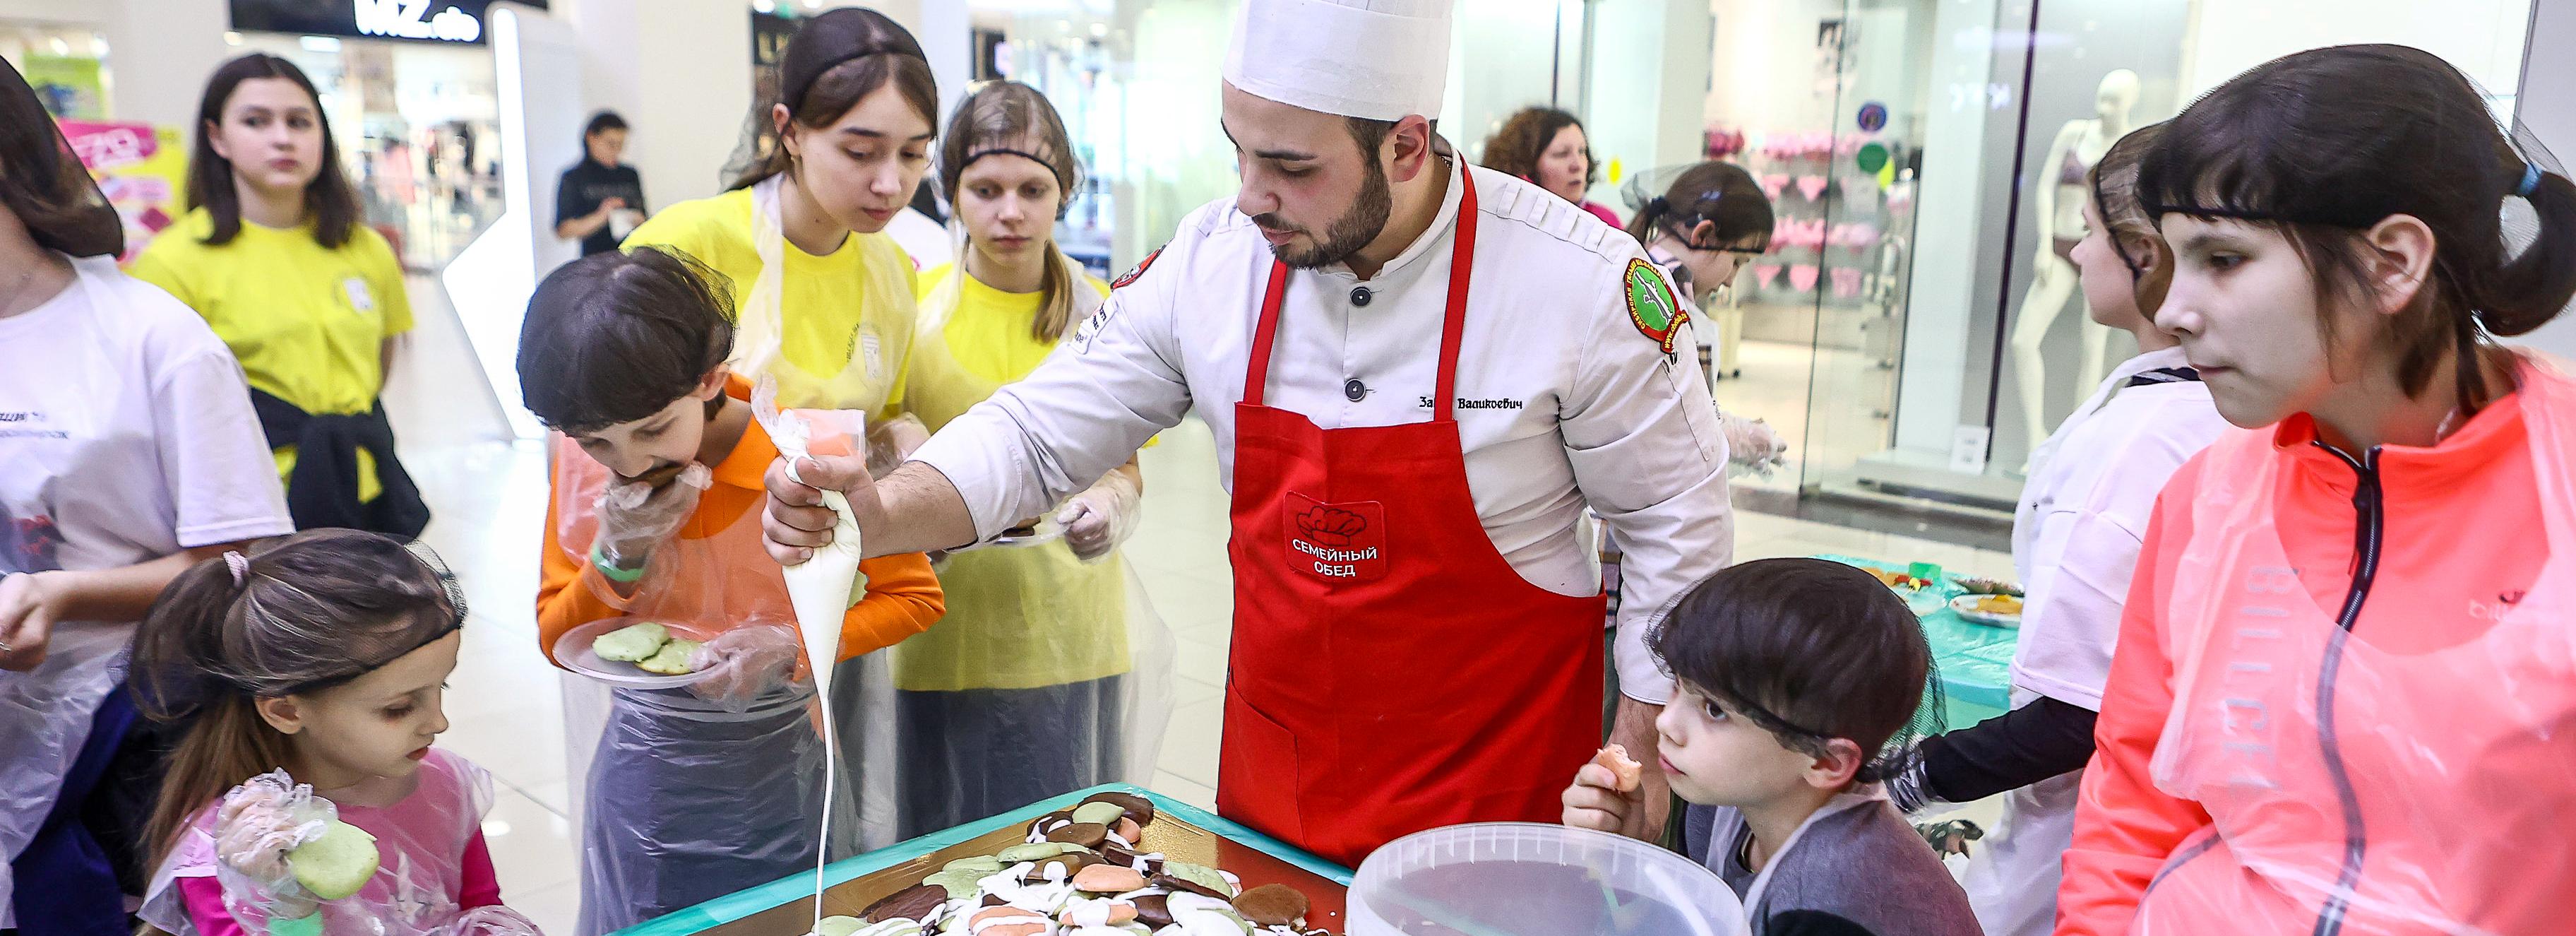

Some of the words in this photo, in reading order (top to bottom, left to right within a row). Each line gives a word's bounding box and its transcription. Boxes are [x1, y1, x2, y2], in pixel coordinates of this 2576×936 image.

[1457, 398, 1522, 410] Валикоевич
[1292, 538, 1377, 562] СЕМЕЙНЫЙ
[1314, 561, 1356, 578] ОБЕД
